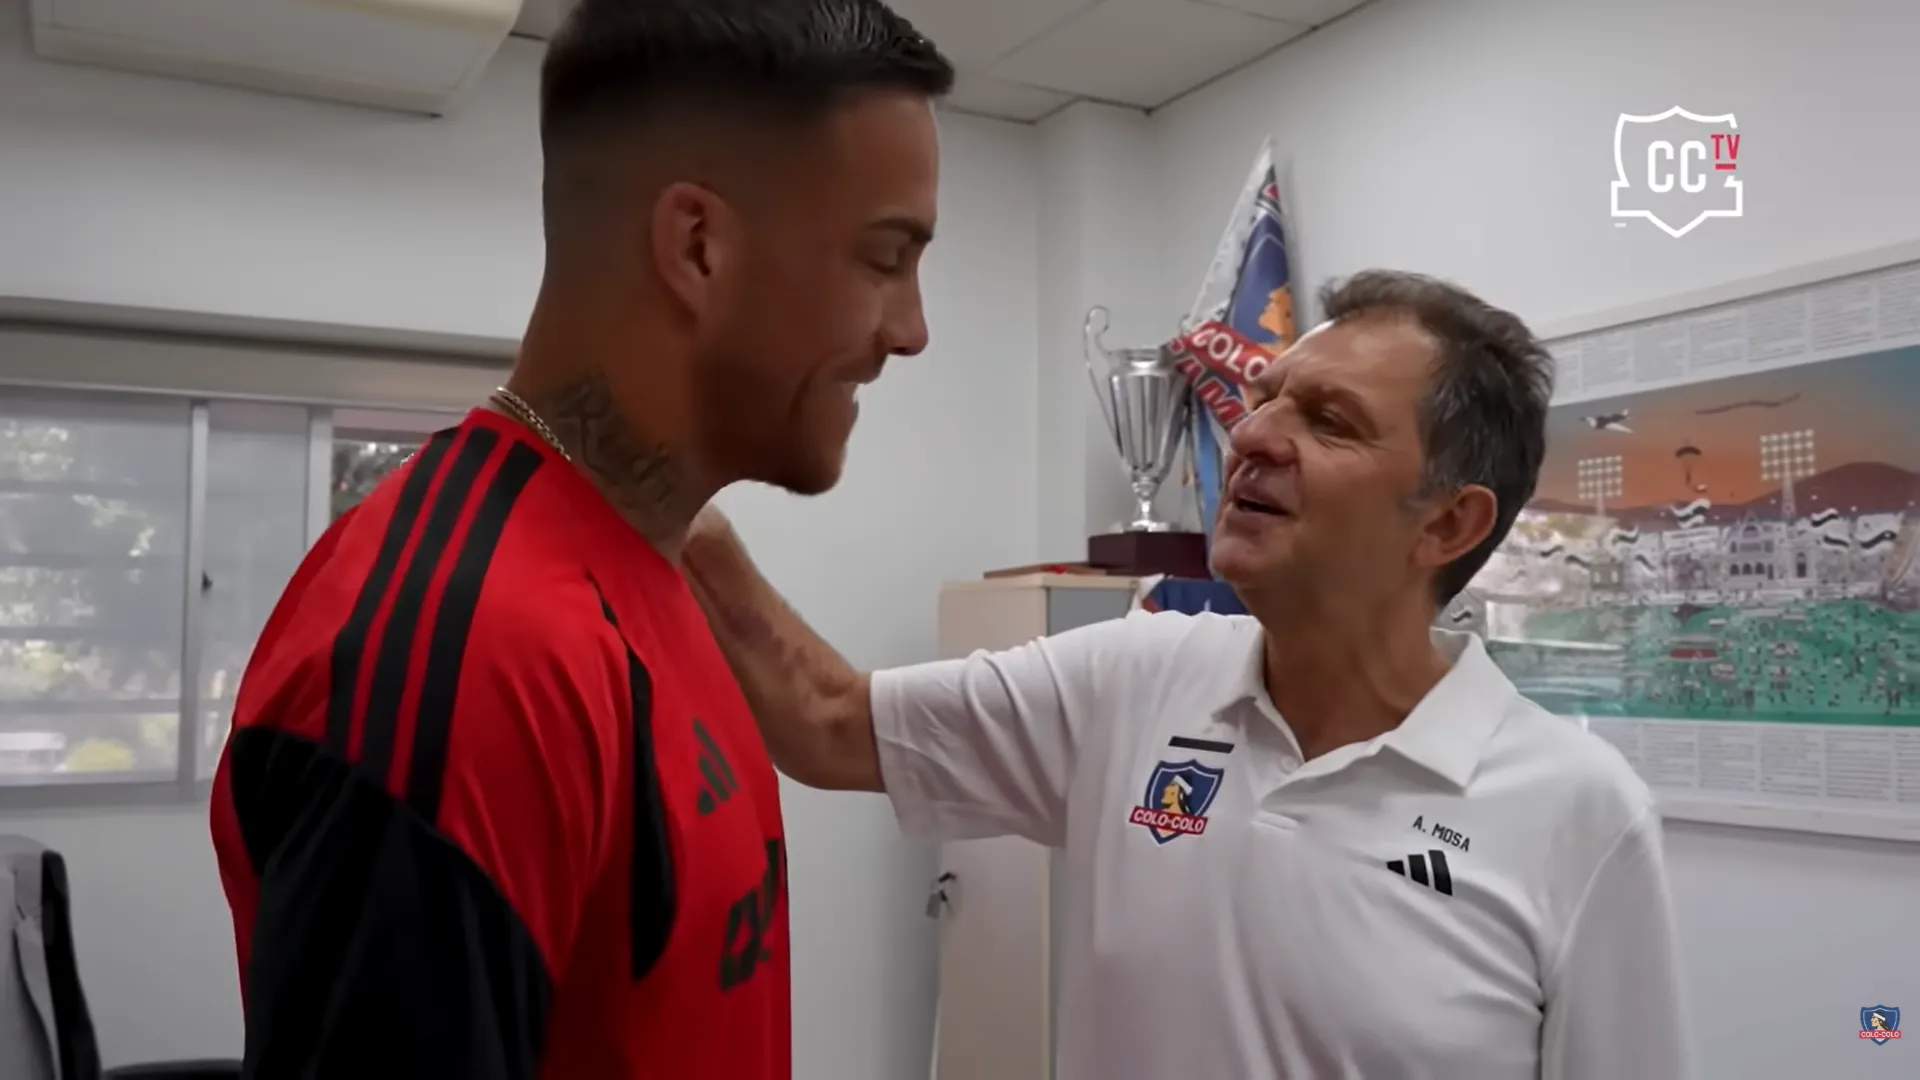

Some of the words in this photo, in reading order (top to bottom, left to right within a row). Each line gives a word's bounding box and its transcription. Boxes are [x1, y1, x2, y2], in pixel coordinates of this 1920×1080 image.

[1132, 808, 1206, 833] COLO-COLO
[1412, 814, 1426, 834] A.
[1431, 822, 1471, 853] MOSA
